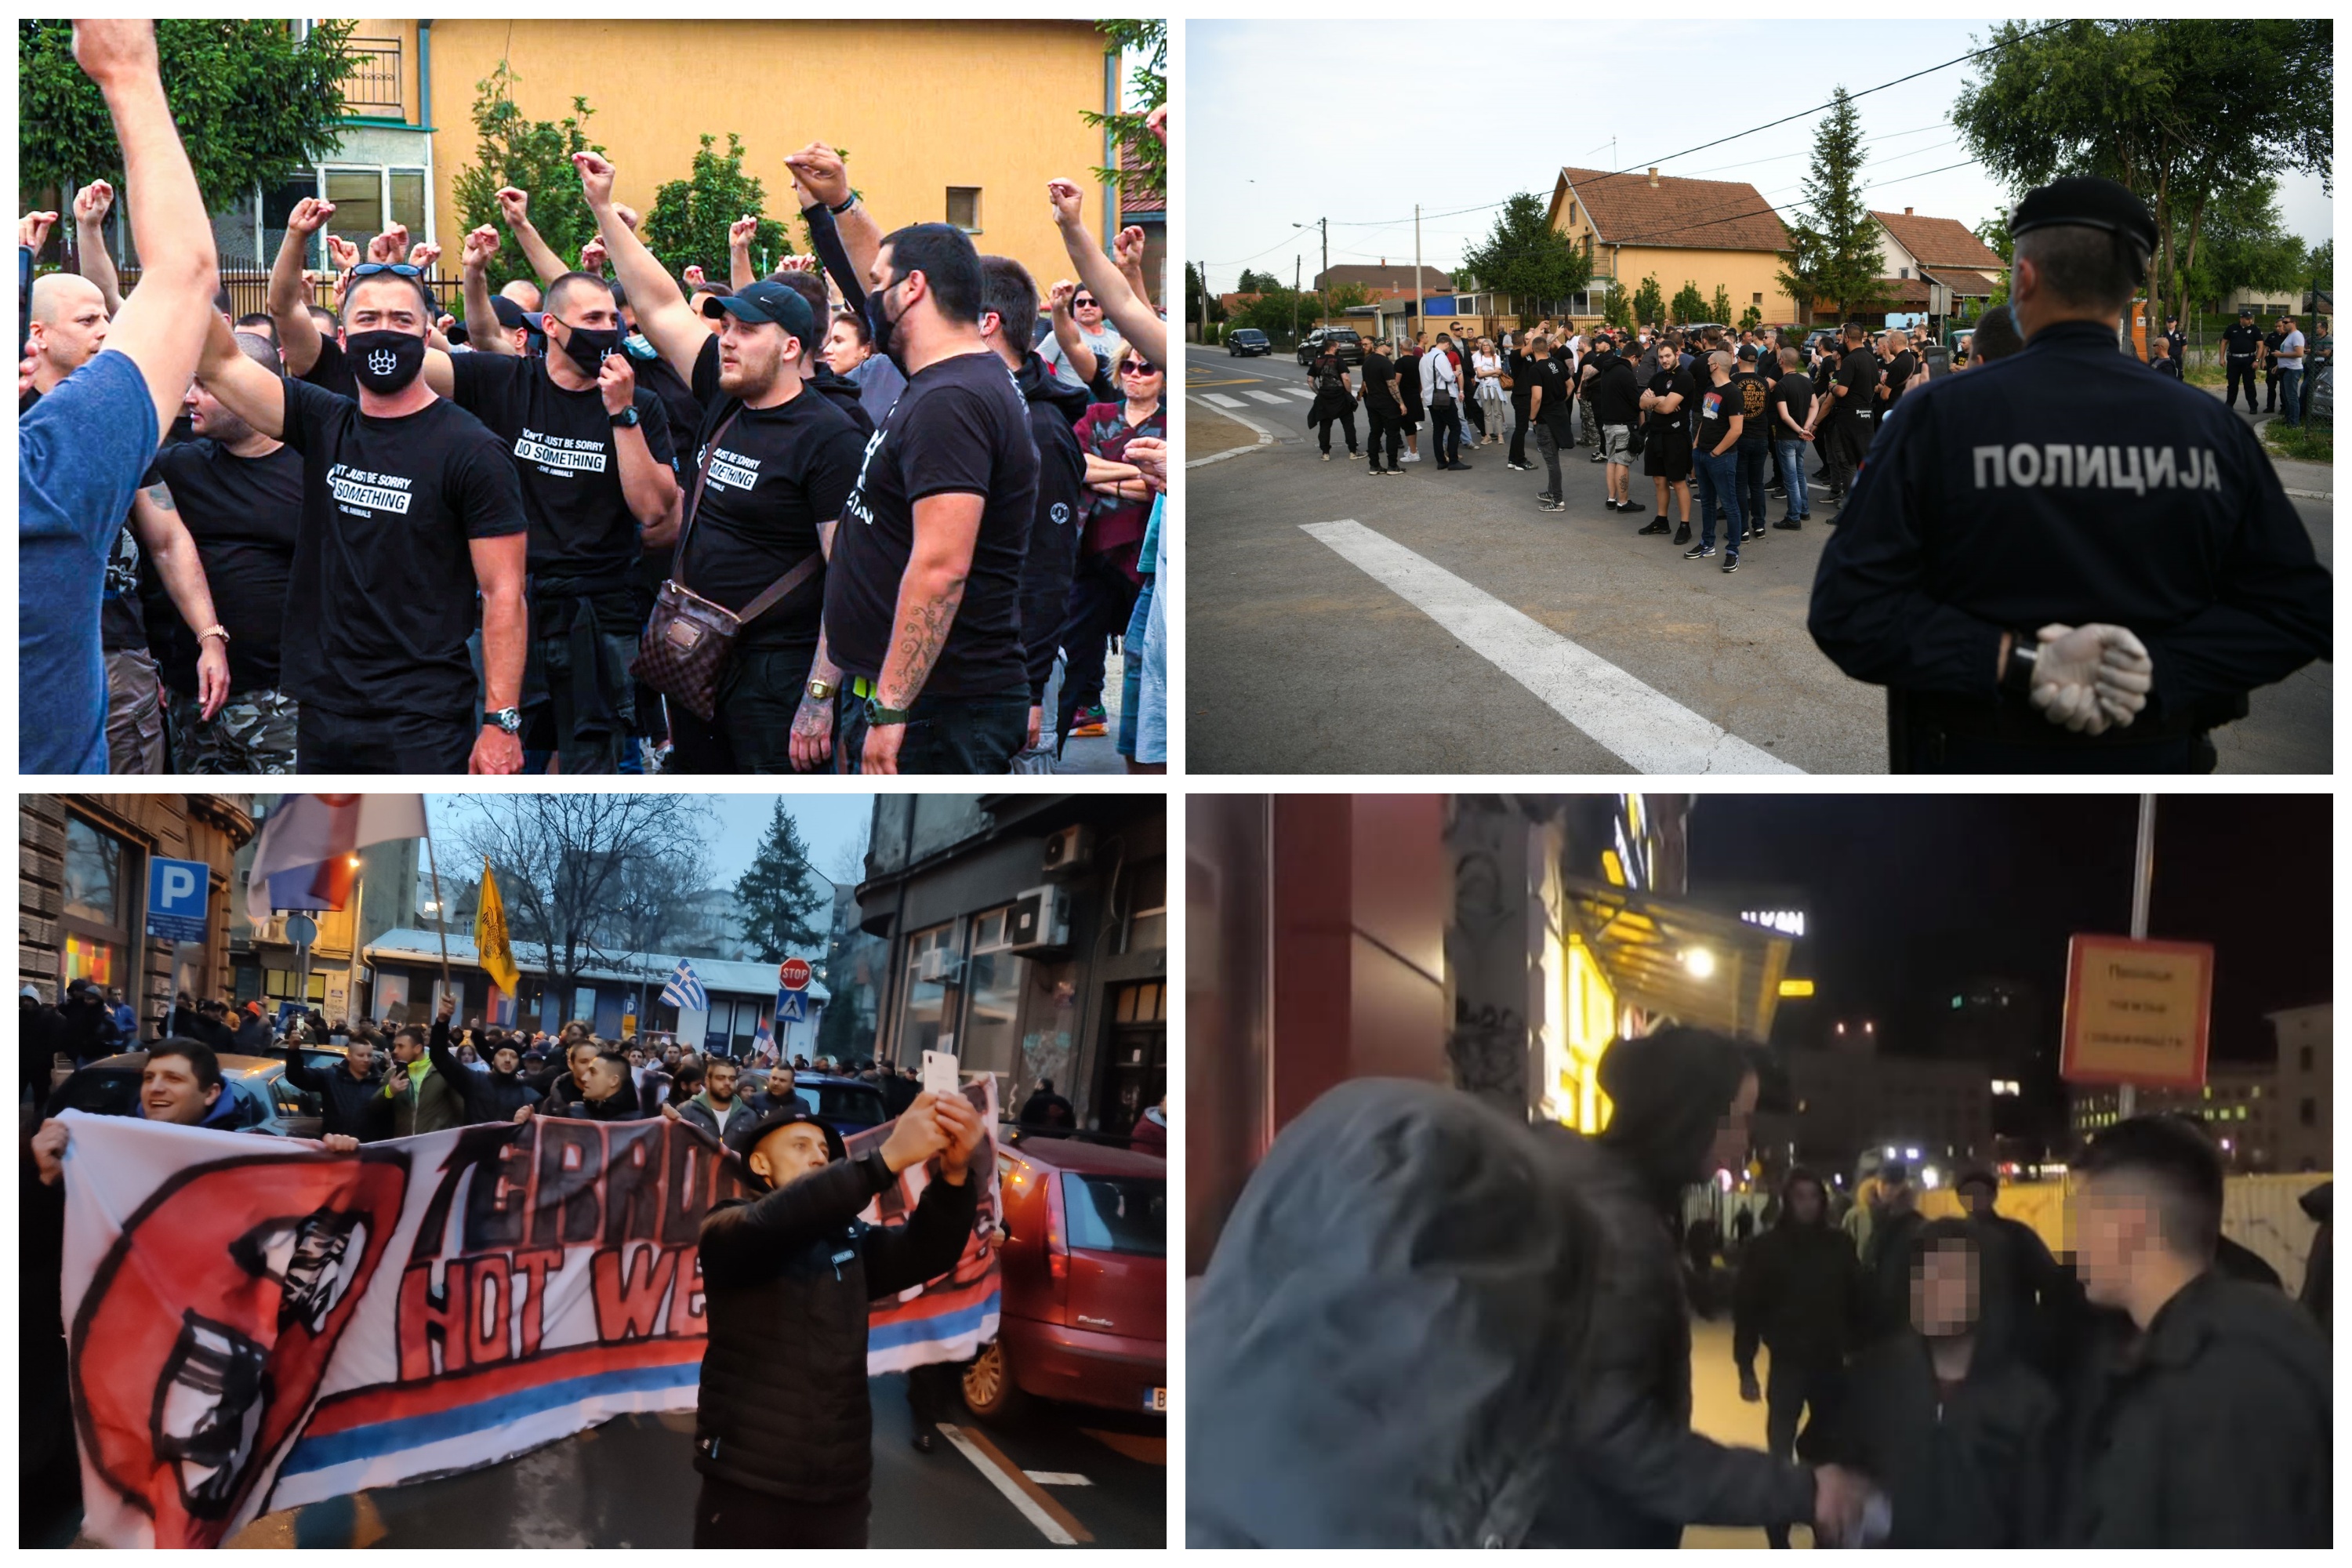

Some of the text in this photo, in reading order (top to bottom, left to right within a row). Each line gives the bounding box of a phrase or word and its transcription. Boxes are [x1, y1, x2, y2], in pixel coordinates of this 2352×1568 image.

[544, 435, 564, 448] JUST
[564, 438, 575, 449] BE
[575, 440, 604, 452] SORRY
[533, 445, 603, 470] SOMETHING
[728, 452, 739, 463] BE
[1973, 442, 2222, 496] ПОЛИЦИЈА
[345, 468, 367, 483] JUST
[366, 471, 379, 485] BE
[377, 474, 412, 490] SORRY
[336, 481, 407, 510] SOMETHING
[161, 865, 195, 909] P
[782, 967, 808, 980] STOP
[626, 1001, 634, 1014] P
[1077, 1315, 1114, 1327] Punto
